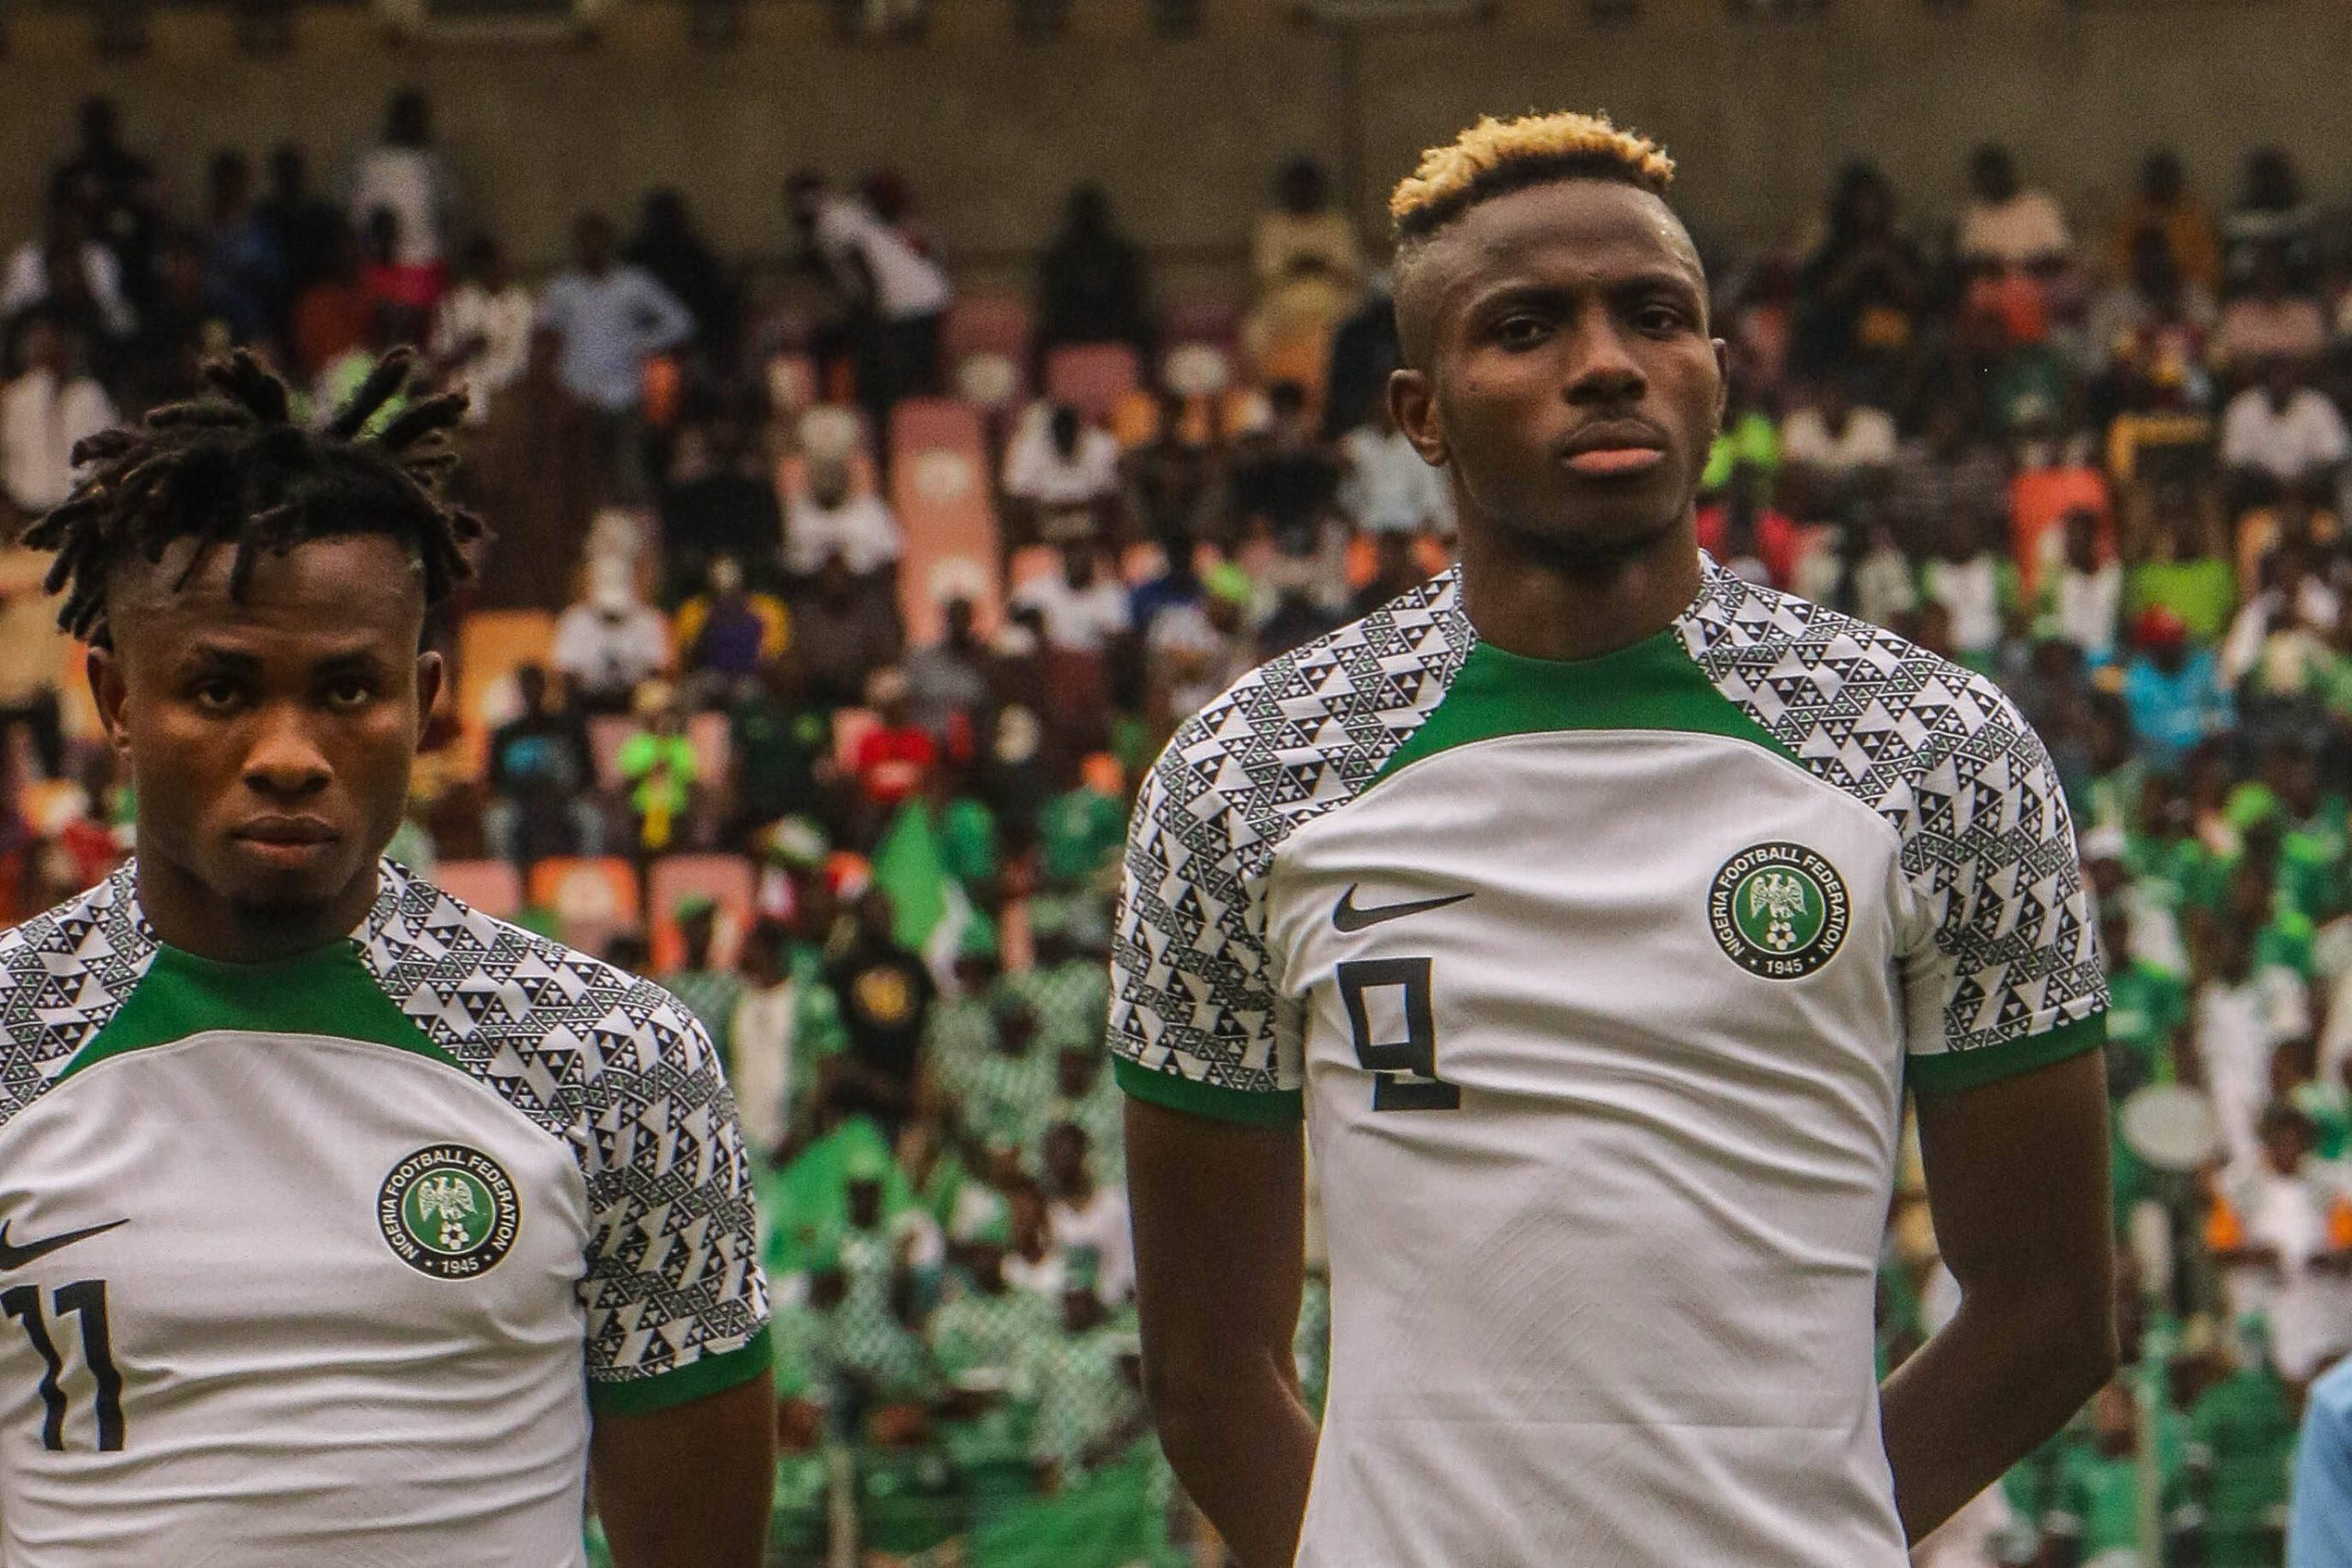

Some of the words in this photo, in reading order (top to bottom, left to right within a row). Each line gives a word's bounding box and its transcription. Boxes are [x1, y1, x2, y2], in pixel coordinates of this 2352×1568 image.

[1718, 847, 1801, 888] FOOTBALL
[1713, 891, 1746, 956] NIGERIA
[1803, 854, 1846, 954] FEDERATION
[1766, 960, 1803, 975] 1945
[1337, 957, 1460, 1111] 9
[385, 1149, 466, 1196] FOOTBALL
[468, 1156, 516, 1251] FEDERATION
[382, 1200, 420, 1259] NIGERIA
[441, 1258, 479, 1273] 1945
[0, 1279, 124, 1450] 11
